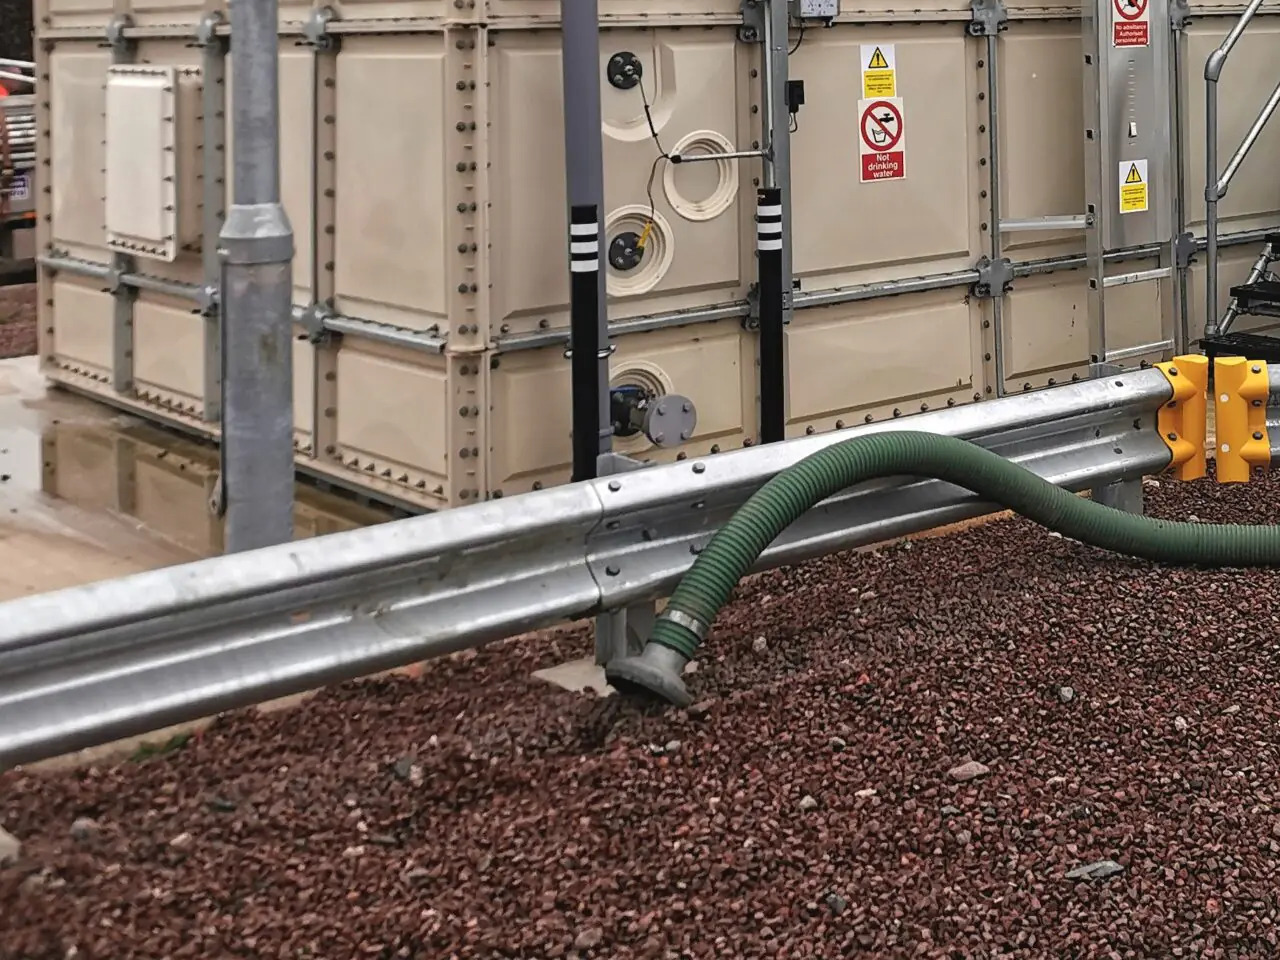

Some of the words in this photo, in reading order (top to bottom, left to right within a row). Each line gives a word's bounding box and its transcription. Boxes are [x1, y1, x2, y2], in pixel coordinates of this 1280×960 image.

[876, 153, 890, 161] Not
[867, 161, 898, 171] drinking
[872, 170, 894, 178] water
